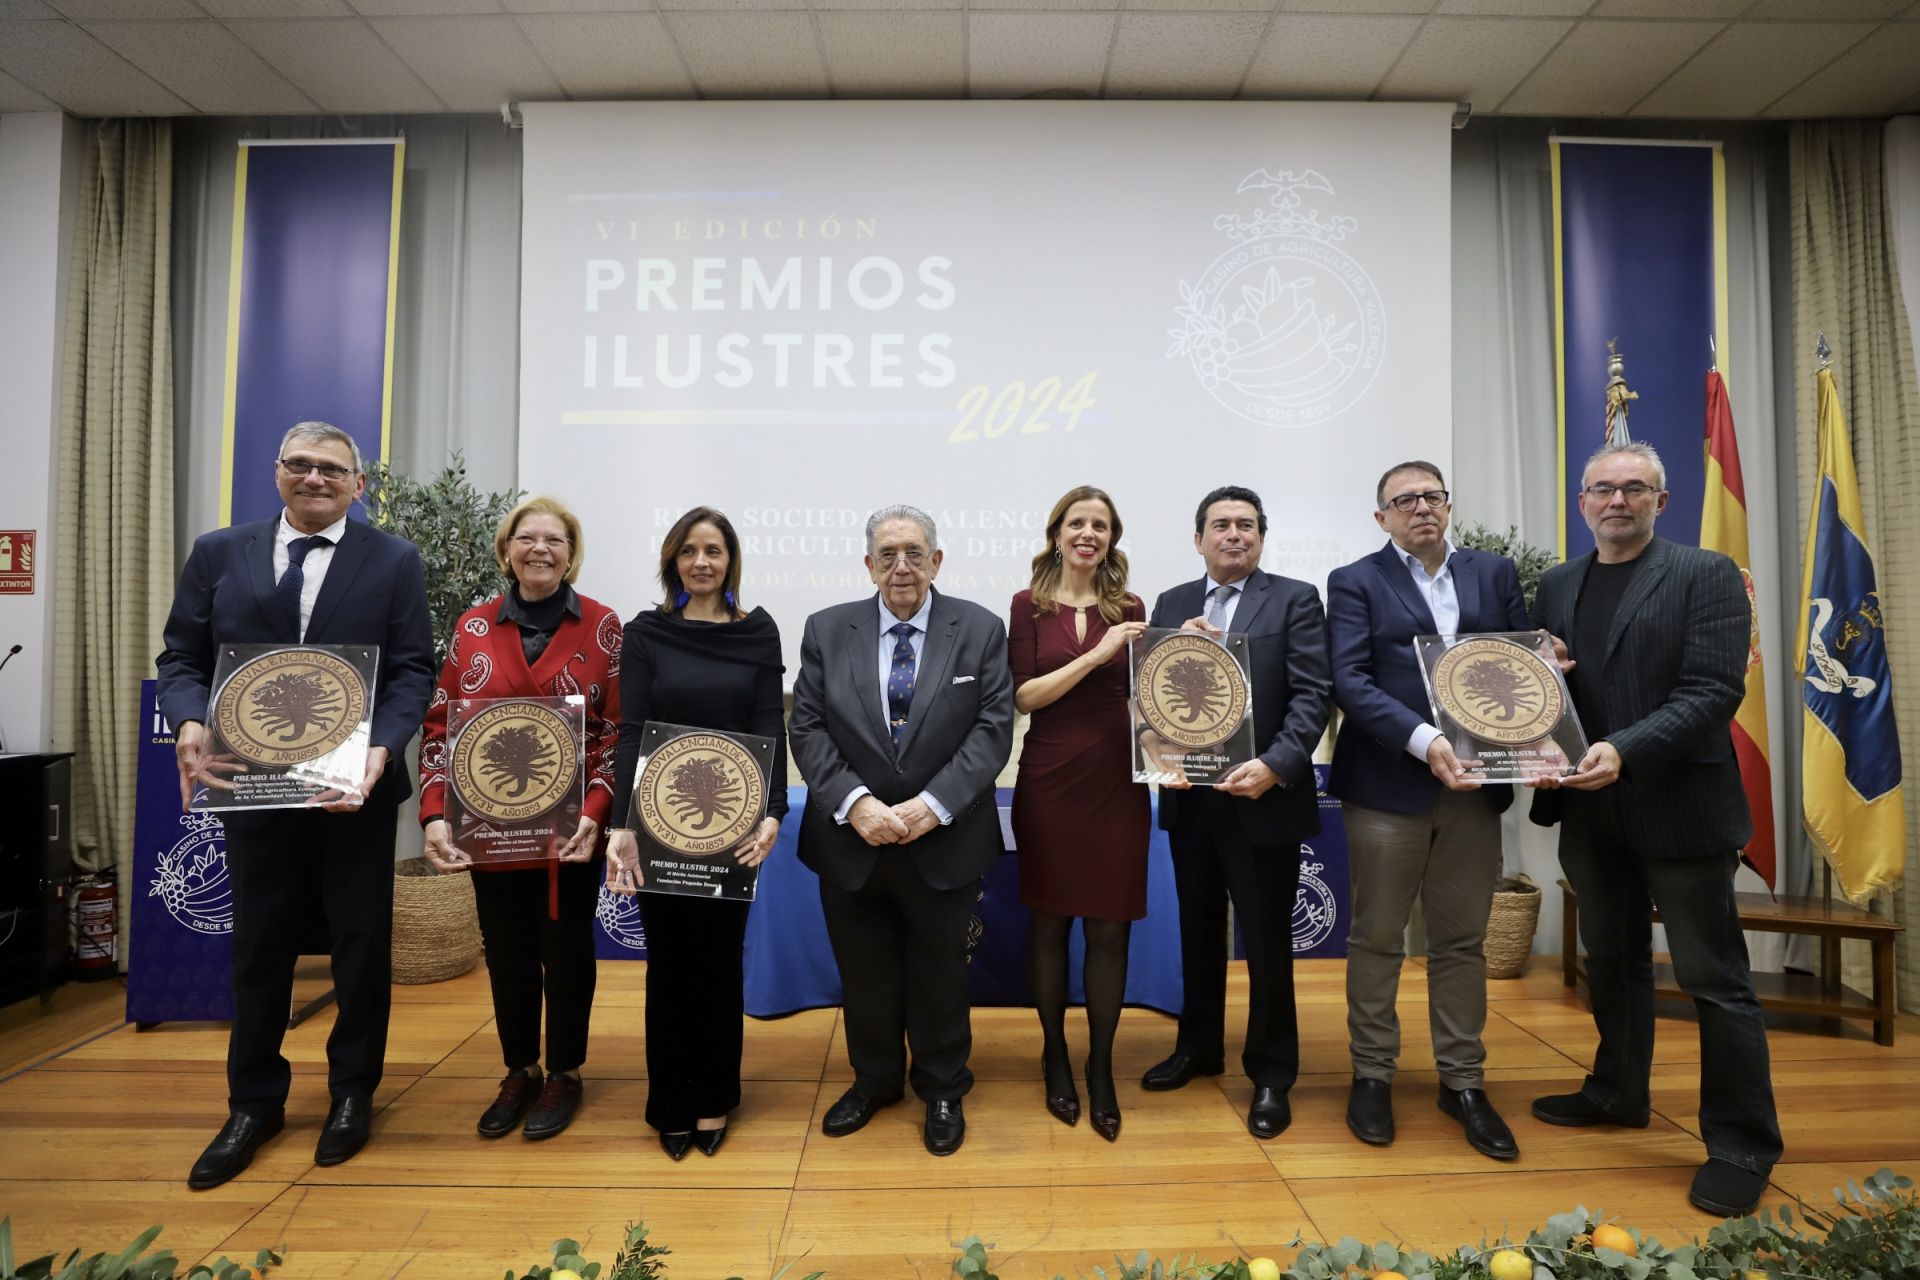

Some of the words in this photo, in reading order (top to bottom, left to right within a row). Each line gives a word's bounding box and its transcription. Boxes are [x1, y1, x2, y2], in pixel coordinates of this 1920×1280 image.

[596, 220, 640, 241] VI
[673, 213, 878, 240] EDICIÓN
[584, 256, 957, 312] PREMIOS
[1204, 250, 1249, 295] CASINO
[1252, 242, 1273, 258] DE
[1277, 241, 1368, 295] AGRICULTURA
[1362, 299, 1382, 370] VALENCIA
[583, 332, 957, 389] ILUSTRES
[948, 370, 1099, 444] 2024
[1245, 402, 1296, 422] DESDE
[1299, 401, 1332, 420] 1859
[742, 508, 868, 529] SOCIED
[1142, 651, 1163, 701] SOCIEDAD
[1437, 661, 1459, 712] SOCIEDAD
[222, 678, 246, 735] SOCIEDAD
[1146, 702, 1167, 730] REAL
[1458, 712, 1486, 734] REAL
[231, 734, 263, 758] REAL
[455, 733, 475, 790] SOCIEDAD
[233, 774, 267, 782] PREMIO
[642, 760, 662, 819] SOCIEDAD
[469, 790, 494, 813] REAL
[474, 831, 502, 839] PREMIO
[504, 829, 532, 837] ILUSTRE
[653, 820, 678, 844] REAL
[172, 836, 200, 861] CASINO
[201, 830, 212, 840] DE
[650, 860, 679, 869] PREMIO
[680, 862, 709, 872] ILUSTRE
[710, 865, 729, 874] 2024
[1299, 875, 1328, 897] RICULTURA
[192, 919, 221, 931] DESDE
[622, 936, 645, 946] DESDE
